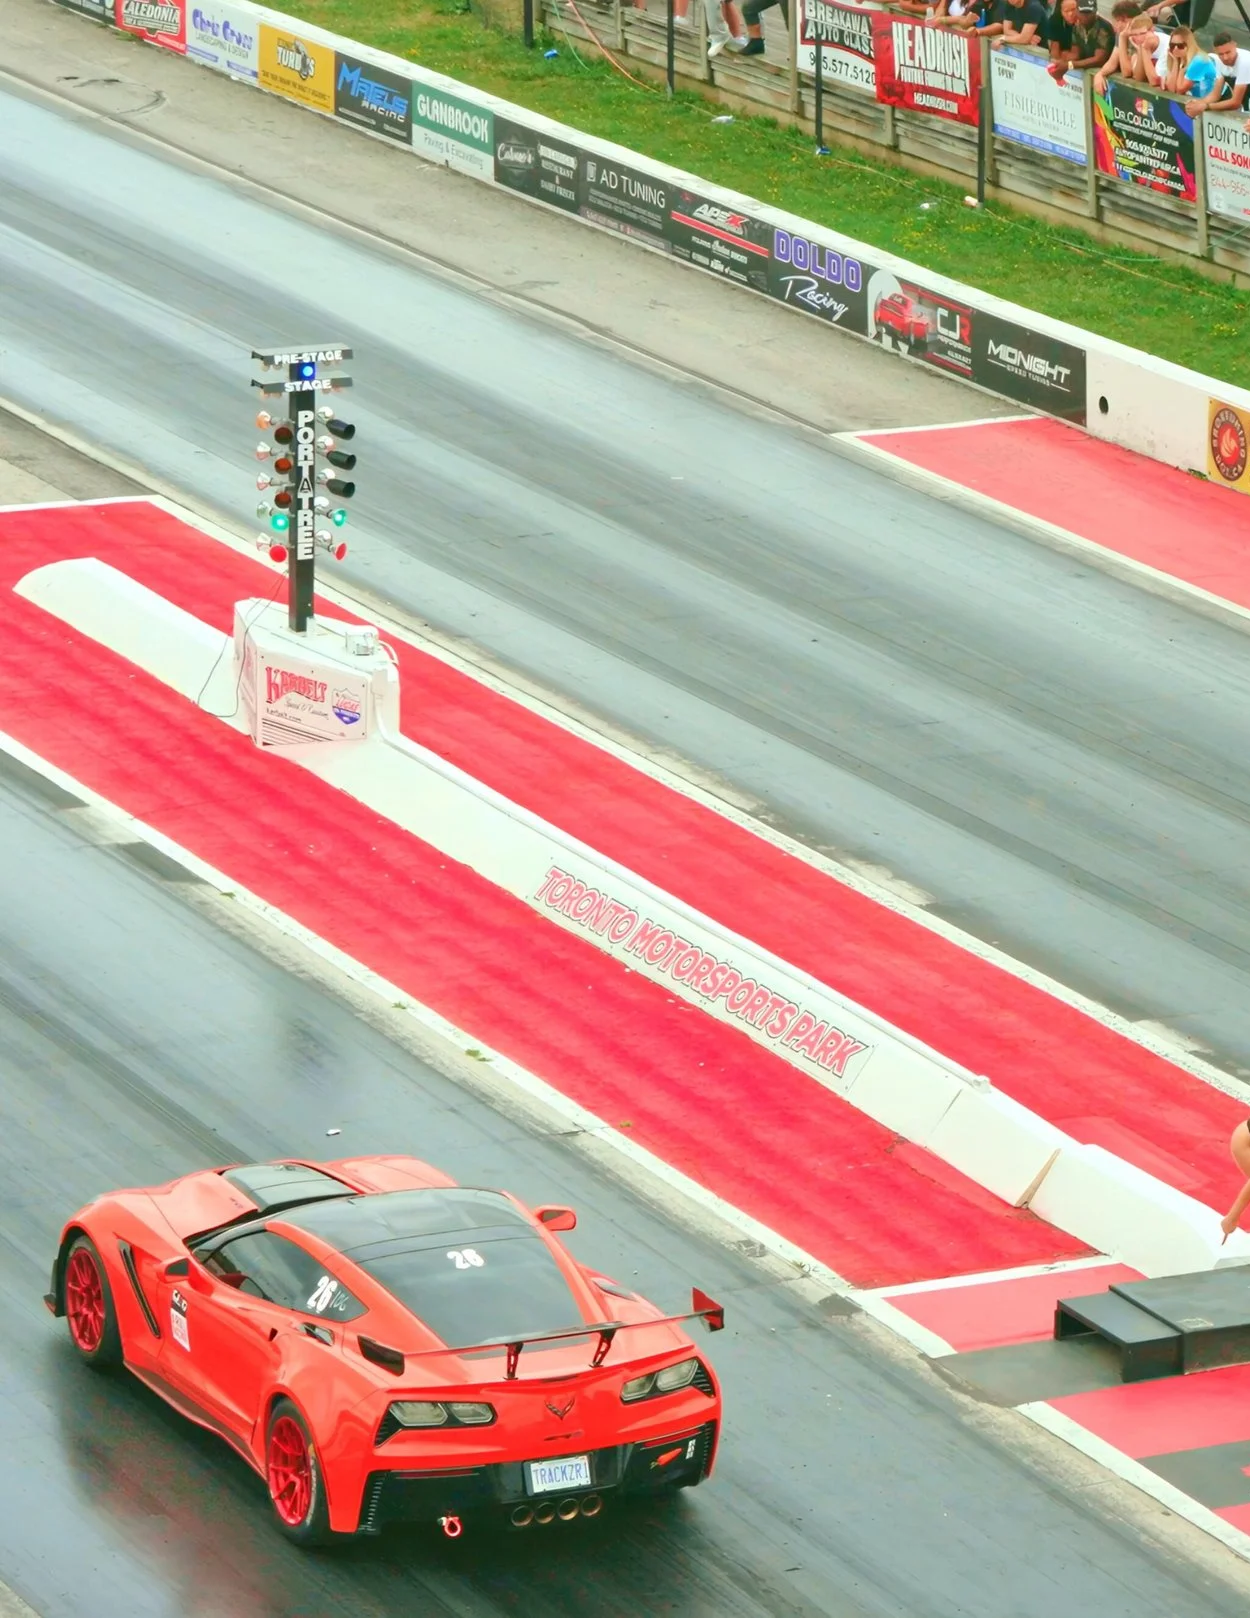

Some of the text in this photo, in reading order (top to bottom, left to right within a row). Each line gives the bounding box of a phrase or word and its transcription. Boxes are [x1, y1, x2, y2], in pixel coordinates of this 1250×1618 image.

[124, 2, 180, 24] CALEDONIA
[805, 0, 873, 37] BREAKAWA
[892, 21, 970, 96] HEADRUSH
[416, 94, 489, 144] GLANBROOK
[1004, 90, 1077, 130] FISHERVILLE
[1208, 122, 1238, 147] DON'T
[1208, 145, 1229, 163] CALL
[600, 169, 665, 208] AD TUNING
[773, 228, 862, 293] DOLDO
[780, 275, 849, 322] Racing
[936, 307, 972, 345] CJR
[274, 350, 343, 365] PRE-STAGE
[987, 339, 1071, 384] MIDNIGHT
[284, 379, 332, 393] STAGE
[534, 866, 869, 1078] TORONTO MOTORSPORTS PARK
